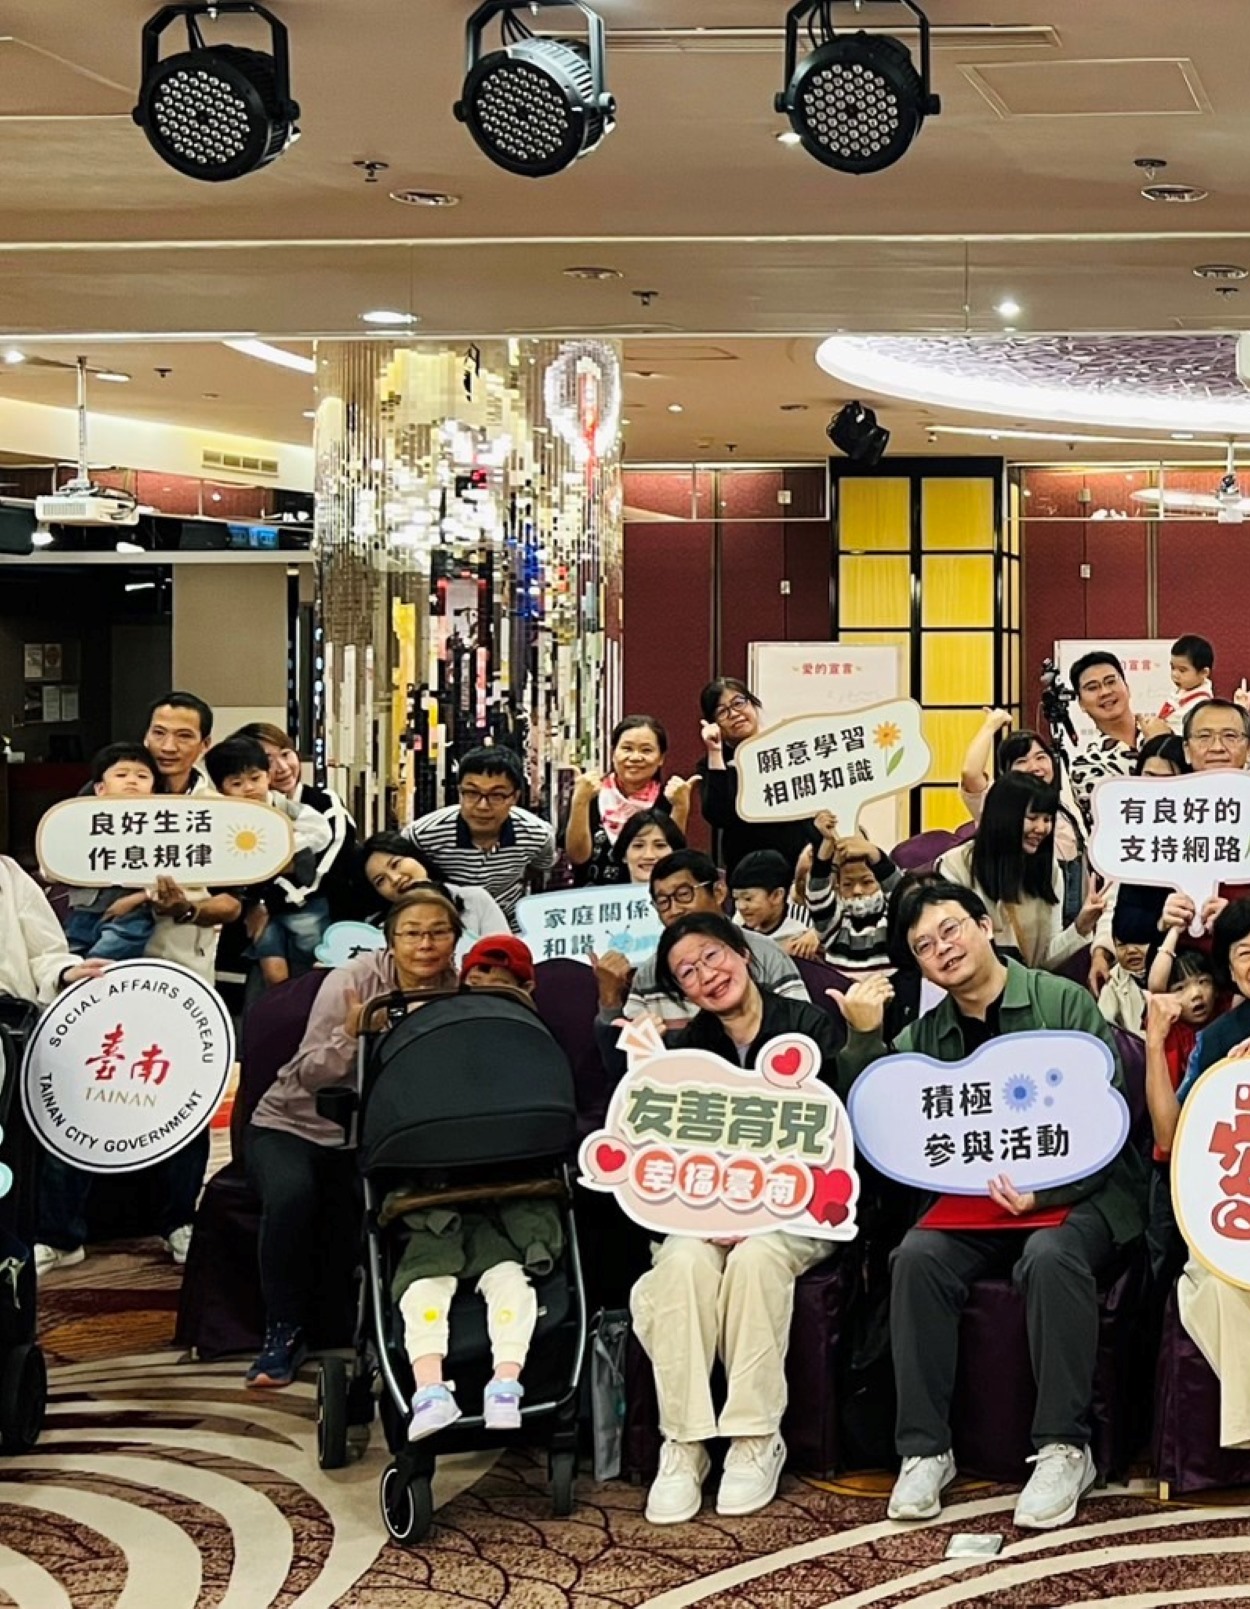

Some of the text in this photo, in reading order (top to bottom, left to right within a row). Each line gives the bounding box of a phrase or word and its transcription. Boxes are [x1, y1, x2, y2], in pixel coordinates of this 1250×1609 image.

[757, 726, 865, 774] 願意學習
[763, 758, 874, 807] 相關知識
[89, 810, 213, 836] 良好生活
[1120, 797, 1242, 826] 有良好的
[88, 843, 213, 871] 作息規律
[1120, 836, 1241, 864] 支持網路
[543, 900, 650, 927] 家庭關係
[543, 935, 596, 957] 和諧
[49, 979, 214, 1064] SOCIAL AFFAIRS BUREAU
[85, 1023, 170, 1085] 臺南
[39, 1072, 203, 1153] TAINAN CITY GOVERNMENT
[84, 1087, 157, 1108] TAINAN
[921, 1082, 993, 1120] 積極
[627, 1087, 828, 1154] 友善育兒
[924, 1124, 1070, 1166] 參與活動
[642, 1160, 799, 1204] 幸福臺南
